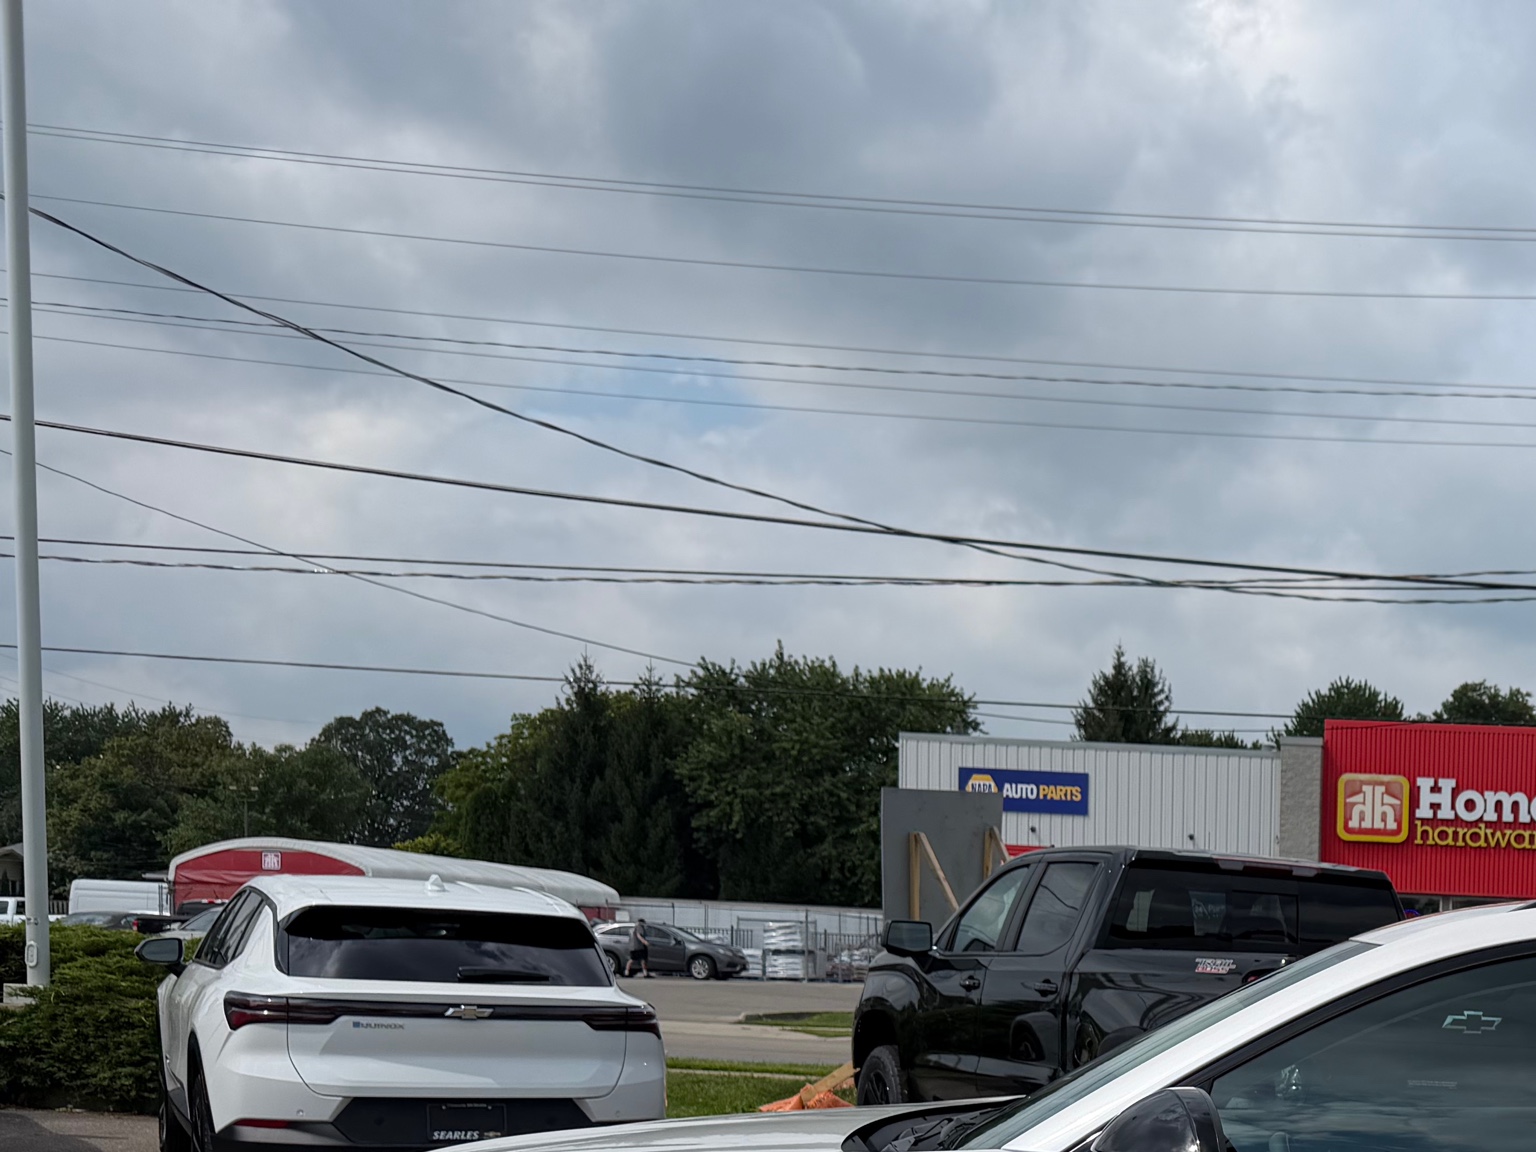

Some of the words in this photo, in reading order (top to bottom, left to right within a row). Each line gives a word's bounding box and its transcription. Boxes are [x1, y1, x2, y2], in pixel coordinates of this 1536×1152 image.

[1003, 782, 1037, 799] AUTO
[1040, 785, 1081, 802] PARTS
[433, 1130, 480, 1140] SEARLES
